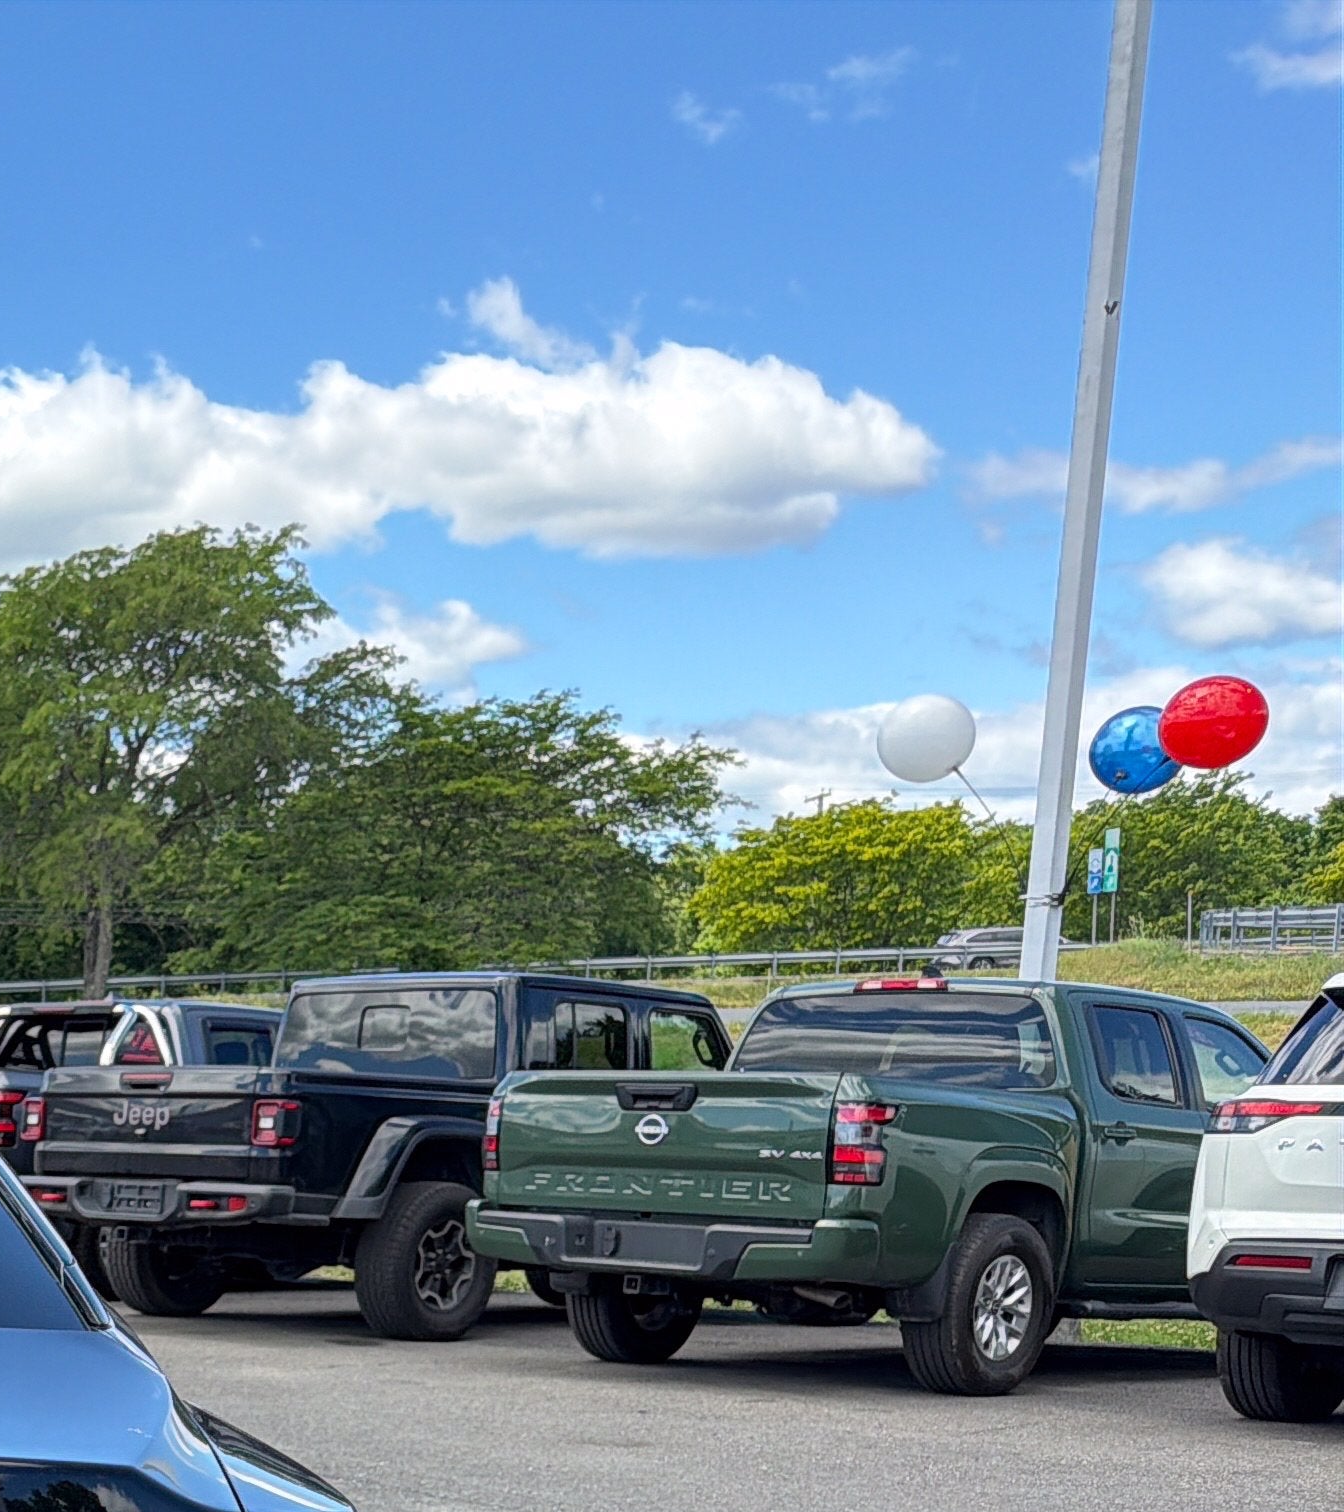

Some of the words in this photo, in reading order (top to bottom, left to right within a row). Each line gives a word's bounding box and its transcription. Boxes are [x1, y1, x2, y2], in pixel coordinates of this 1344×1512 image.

[113, 1099, 170, 1130] Jeep
[758, 1149, 785, 1159] SV
[524, 1172, 792, 1201] FRONTIER
